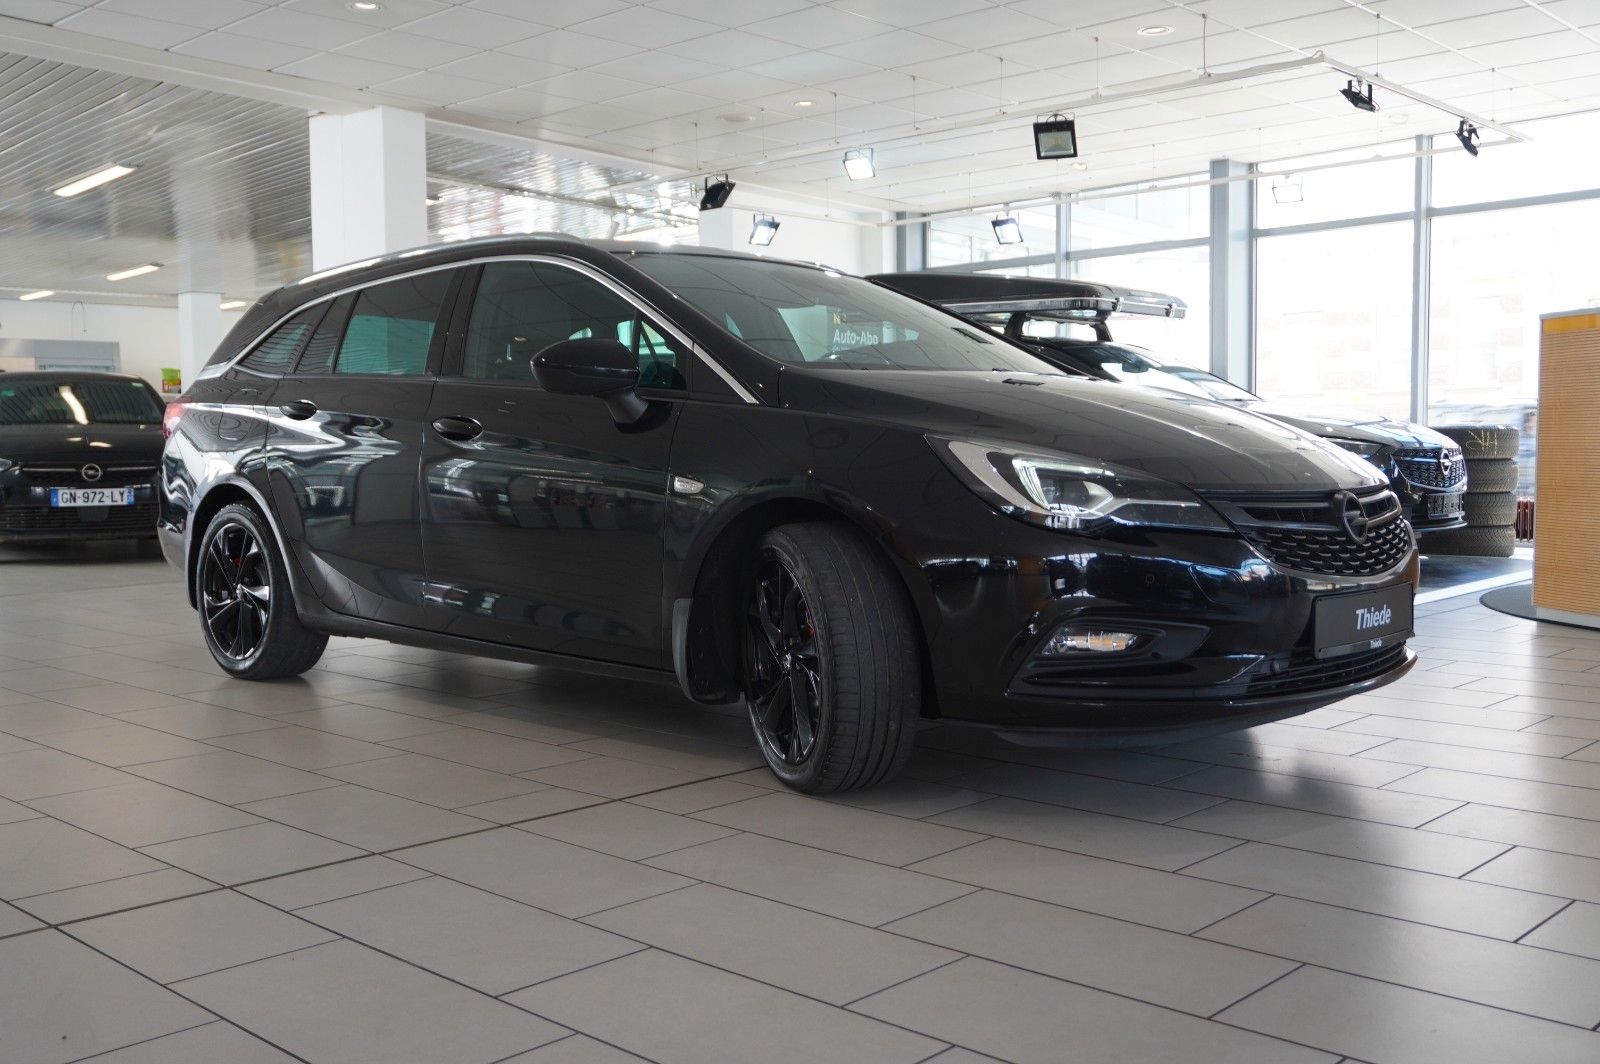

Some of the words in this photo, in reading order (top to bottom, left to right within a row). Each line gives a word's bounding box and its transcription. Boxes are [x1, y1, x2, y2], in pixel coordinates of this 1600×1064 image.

[833, 328, 879, 345] Auto-Abo
[61, 490, 125, 504] GN-972-LY
[1355, 604, 1392, 630] Thiede
